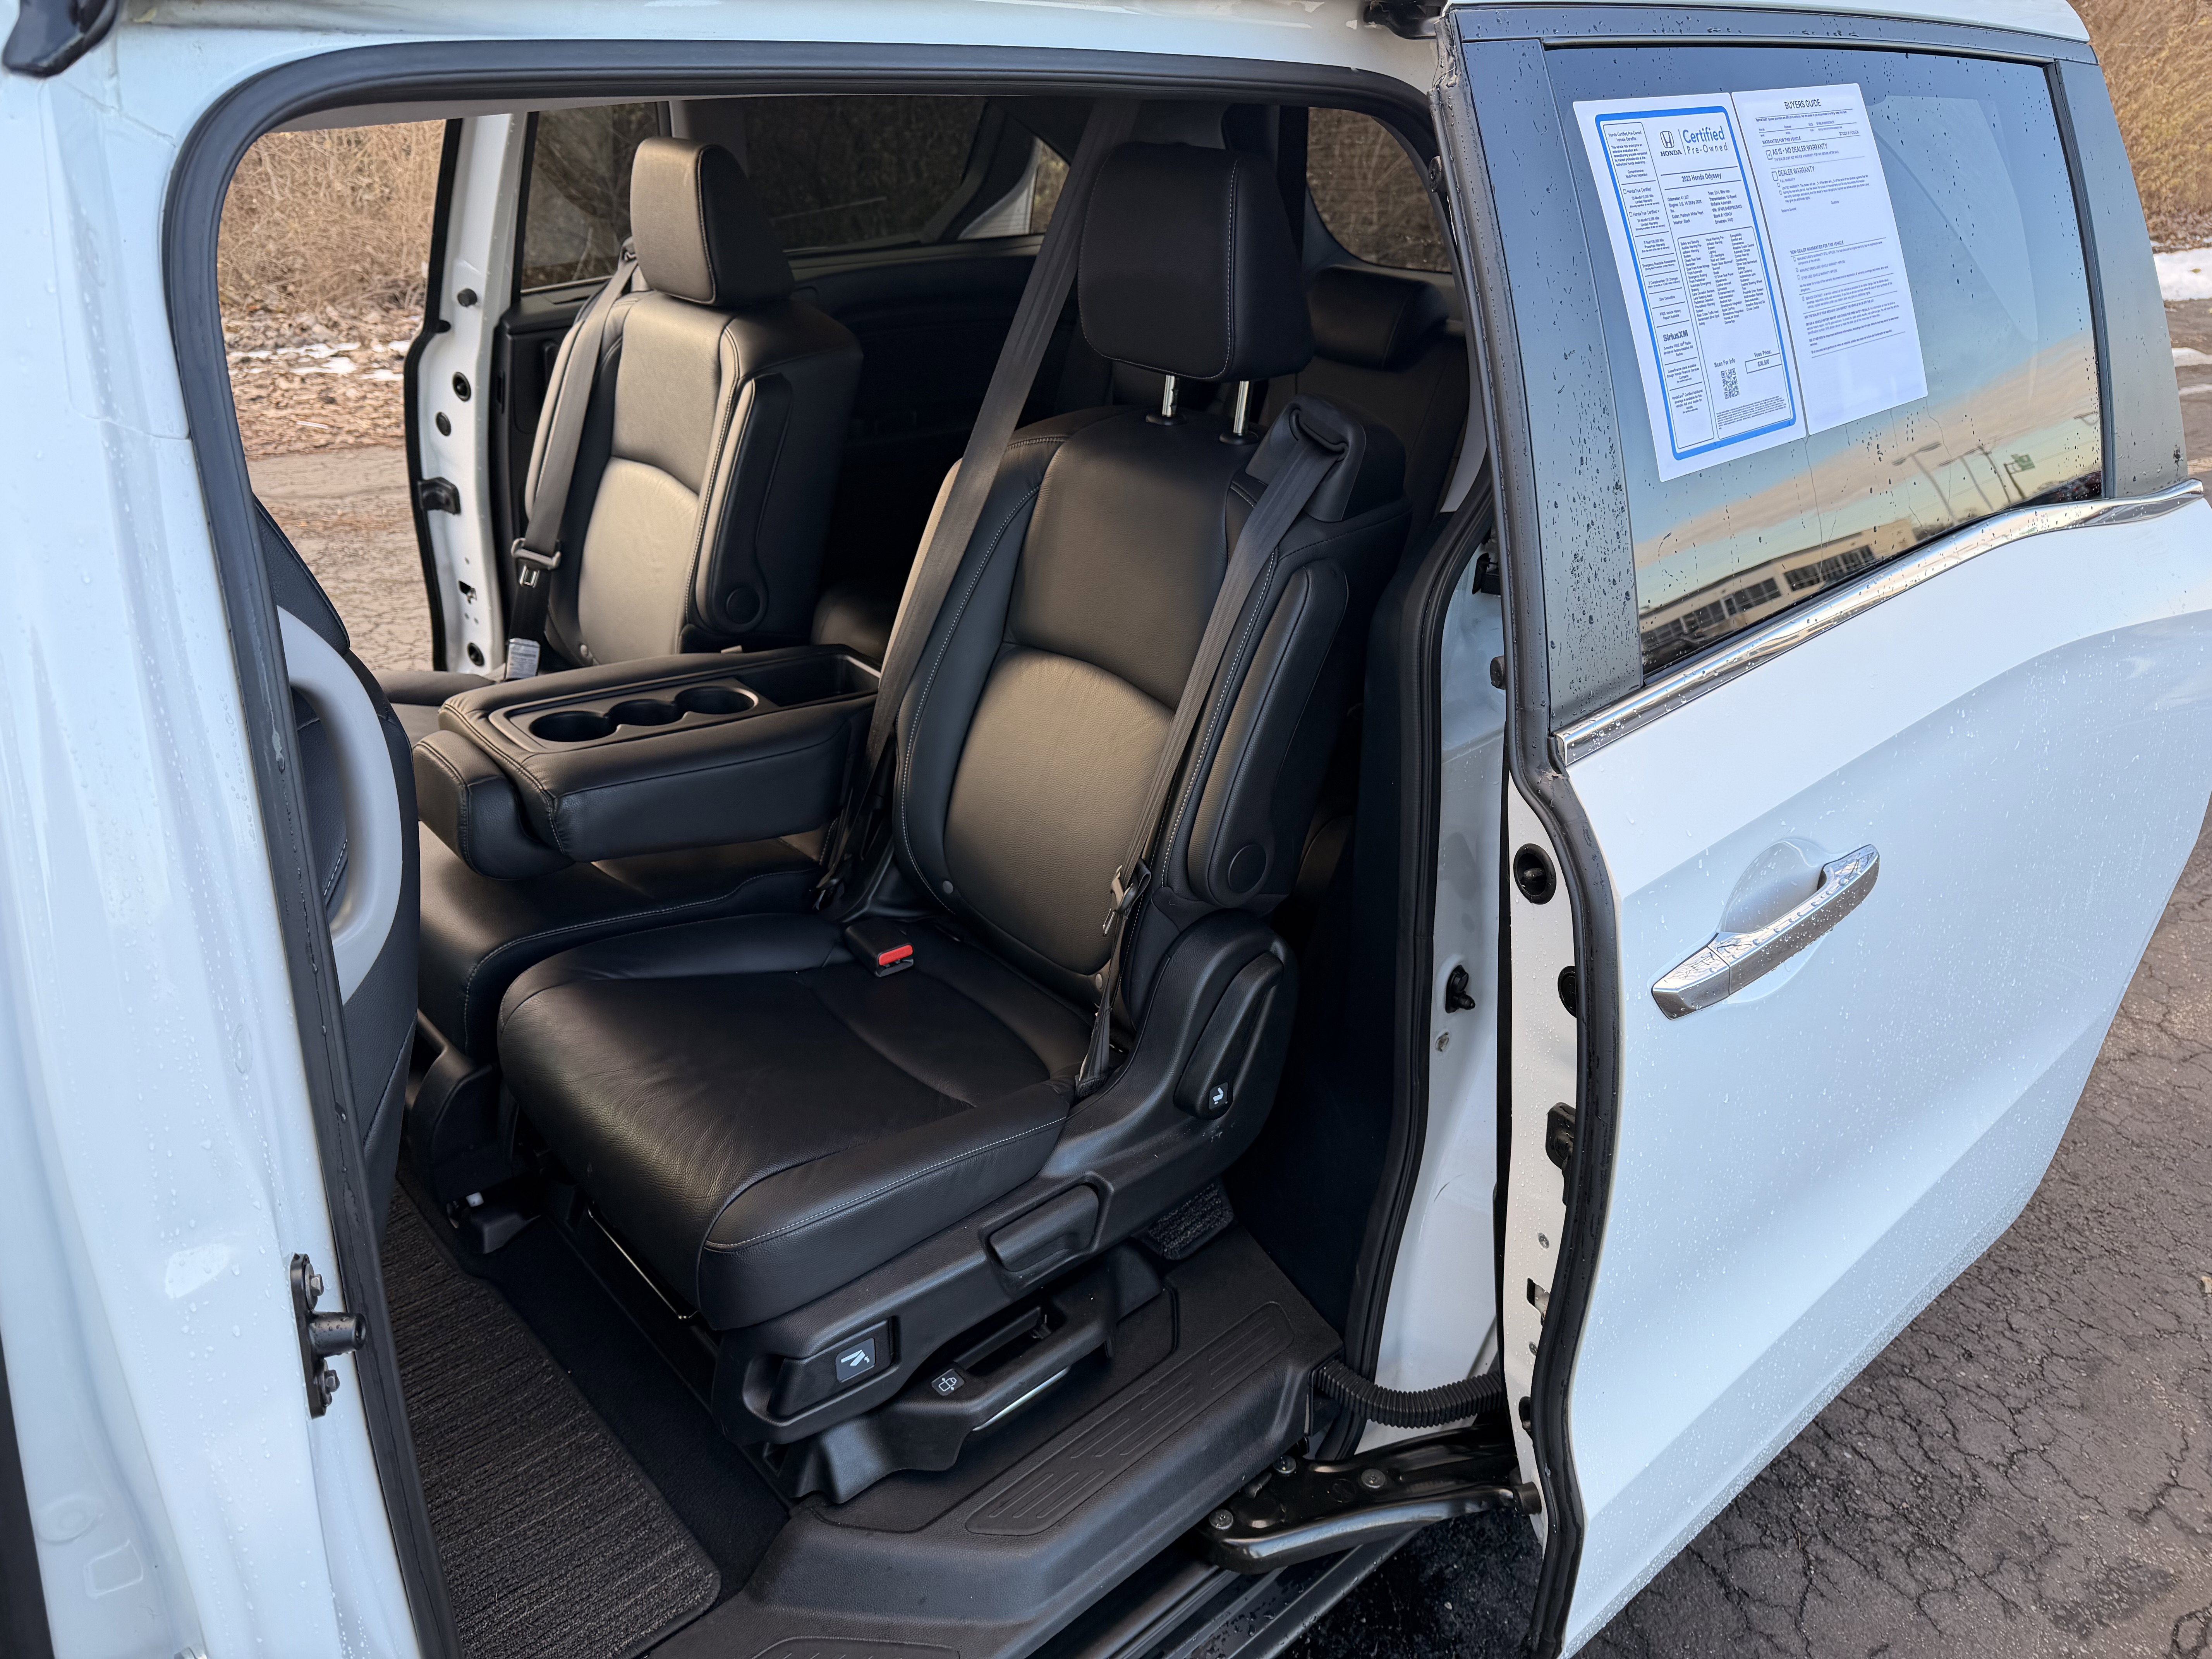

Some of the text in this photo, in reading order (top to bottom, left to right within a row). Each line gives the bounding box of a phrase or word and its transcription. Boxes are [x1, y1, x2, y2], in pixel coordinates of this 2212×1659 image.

[1784, 99, 1821, 109] BUYERS GUIDE
[1683, 125, 1725, 143] Certified
[1687, 142, 1728, 154] Pre-Owned
[1793, 166, 1814, 174] WARRANTY
[1663, 330, 1688, 342] SiriusXM
